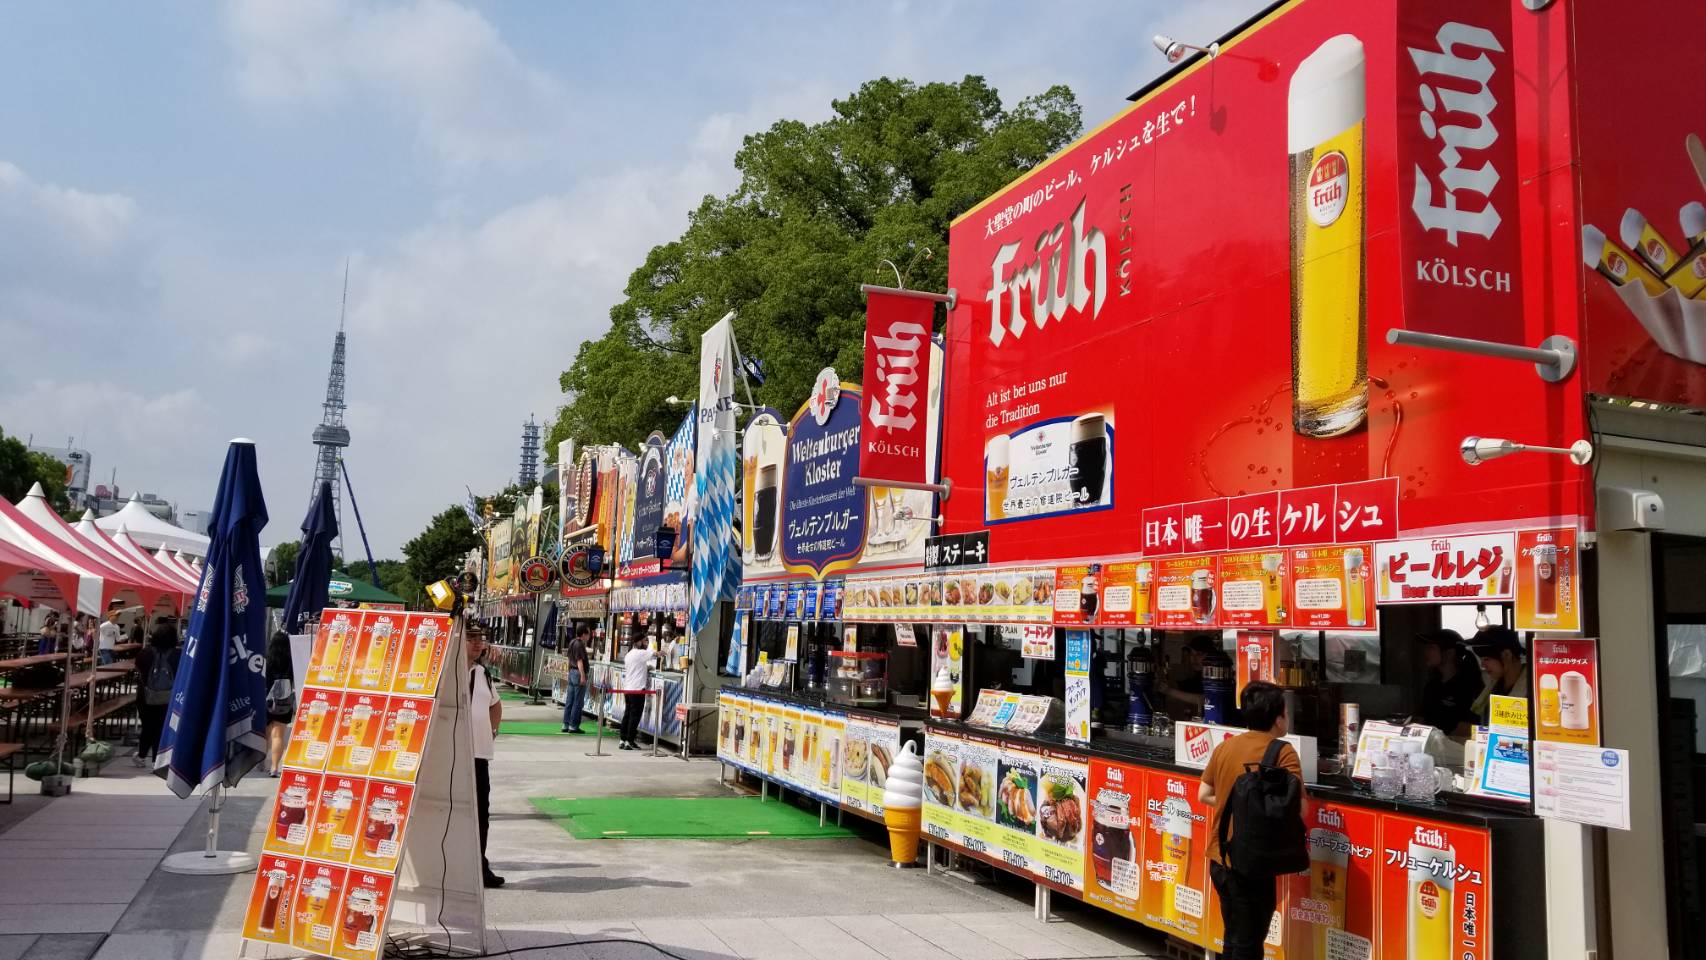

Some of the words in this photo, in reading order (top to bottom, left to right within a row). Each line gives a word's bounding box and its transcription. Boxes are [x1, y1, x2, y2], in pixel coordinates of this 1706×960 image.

[1406, 21, 1506, 248] früh
[1116, 183, 1134, 297] KÖLSCH
[984, 193, 1107, 348] früh
[1416, 257, 1511, 292] KÖLSCH
[868, 321, 928, 435] früh
[986, 391, 998, 408] Alt
[1000, 389, 1011, 403] ist
[1013, 383, 1027, 399] bei
[1029, 379, 1046, 393] uns
[1049, 371, 1068, 388] nur
[986, 413, 999, 428] die
[1000, 402, 1041, 424] Tradition
[792, 425, 861, 465] Weltenburger
[868, 441, 920, 458] KÖLSCH
[805, 457, 842, 487] Kloster
[1010, 465, 1080, 490] ヴェルテンブルガー
[788, 508, 859, 540] ヴェルテンブルガー
[1431, 539, 1451, 551] früh
[1389, 545, 1504, 583] ビールレジ
[1401, 584, 1431, 599] Beer
[1433, 582, 1483, 598] cashier
[1190, 741, 1210, 758] früh
[1107, 767, 1122, 782] früh
[1167, 779, 1185, 796] früh
[1318, 808, 1340, 829] früh
[1305, 836, 1374, 858] ーパーフェストビア
[1415, 826, 1443, 850] früh
[1385, 847, 1483, 885] フリューケルシュ
